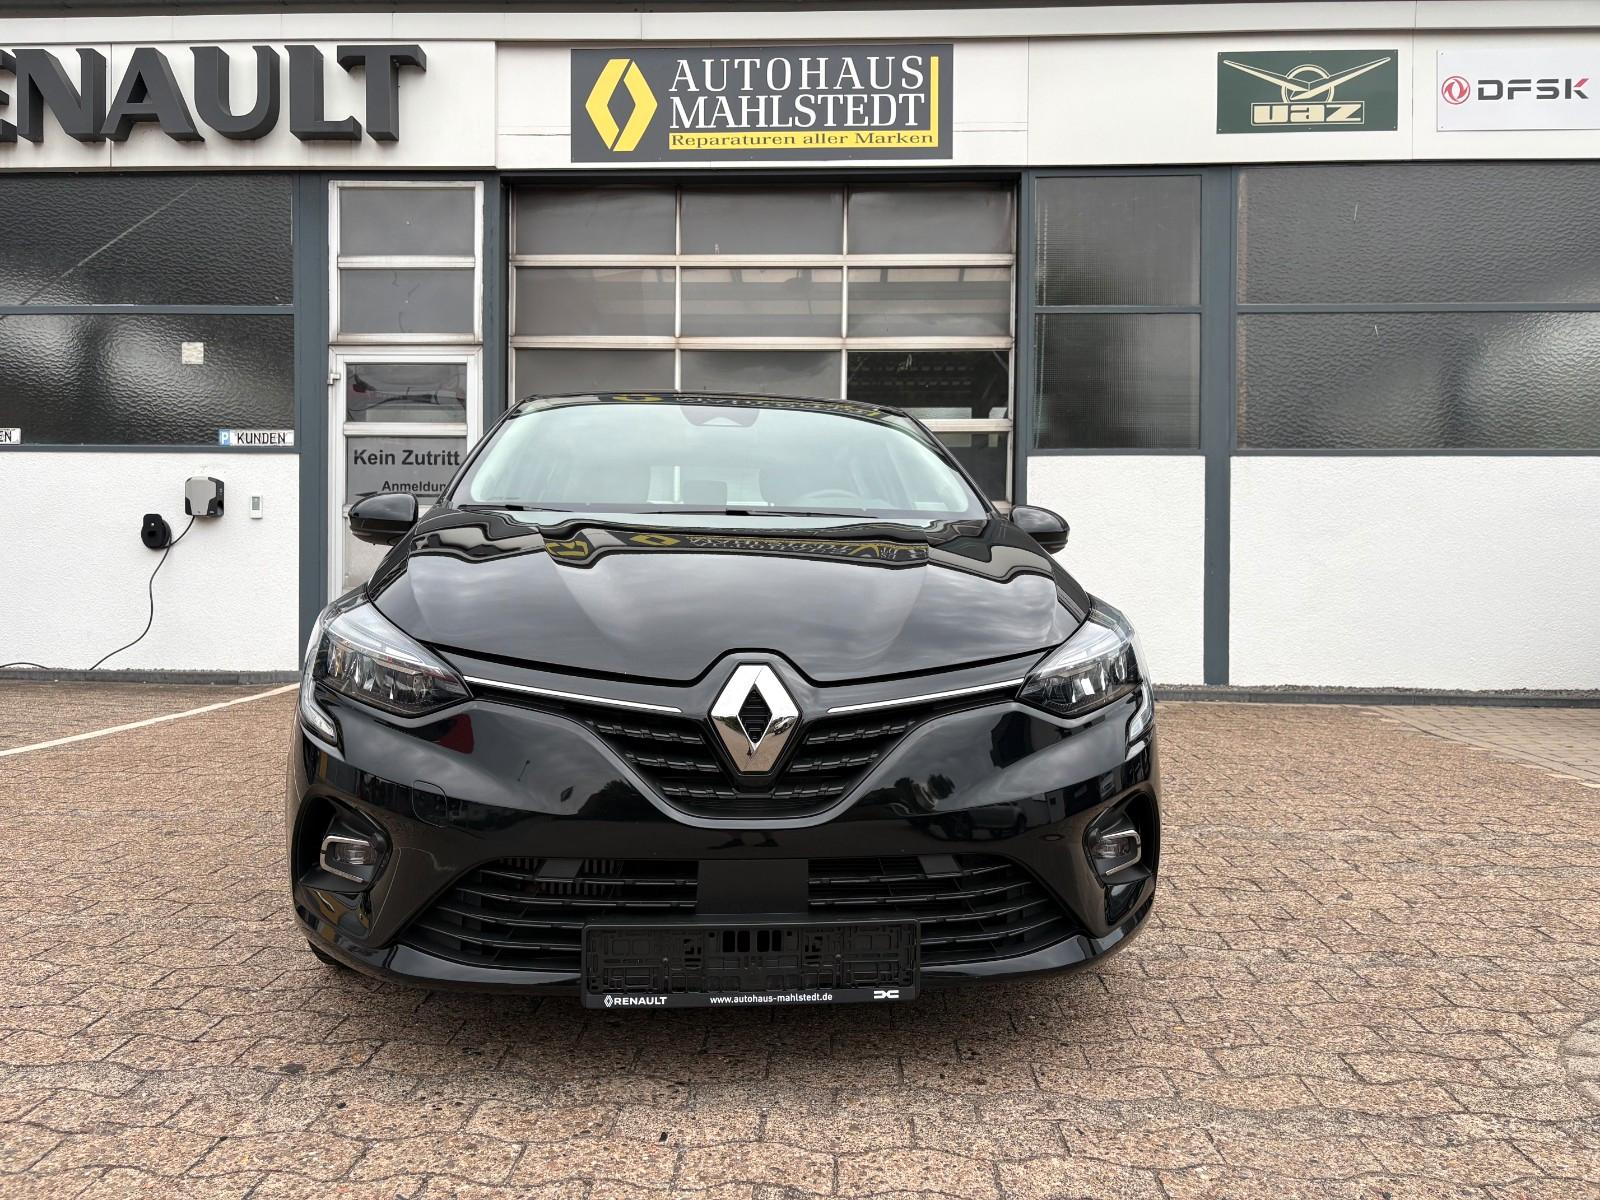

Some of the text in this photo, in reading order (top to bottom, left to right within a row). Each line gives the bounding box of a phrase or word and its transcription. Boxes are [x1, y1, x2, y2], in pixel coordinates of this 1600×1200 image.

[668, 55, 925, 92] AUTOHAUS
[1477, 78, 1590, 101] DFSK
[668, 93, 926, 129] MAHLSTEDT
[671, 131, 934, 148] Reparaturen aller Marken
[237, 432, 286, 445] KUNDEN
[353, 449, 460, 466] Kein Zutritt
[613, 996, 668, 1006] RENAULT
[709, 992, 833, 1005] www.autohaus-mahlstedt.de
